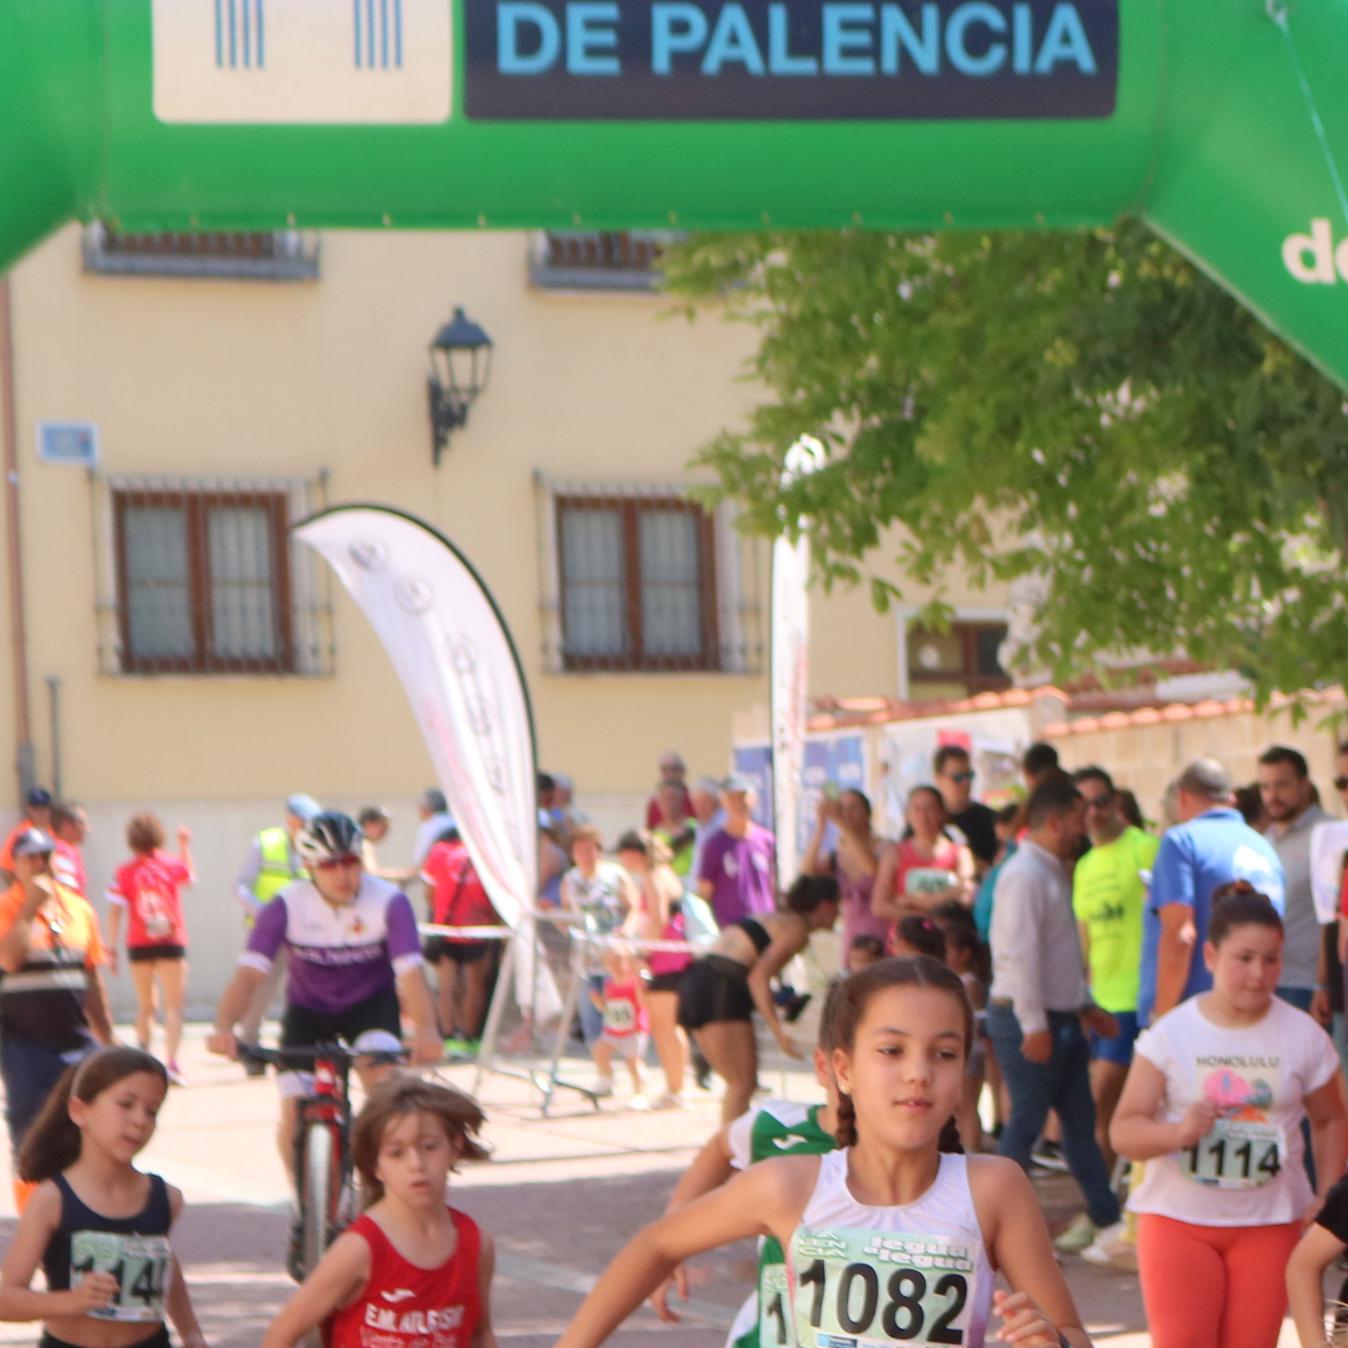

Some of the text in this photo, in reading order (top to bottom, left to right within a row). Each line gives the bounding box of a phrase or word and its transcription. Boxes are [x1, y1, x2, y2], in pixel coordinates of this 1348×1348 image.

[497, 1, 1096, 76] DE PALENCIA
[1195, 1054, 1281, 1070] HONOLULU
[1181, 1136, 1282, 1178] 1114
[799, 1258, 969, 1345] 1082
